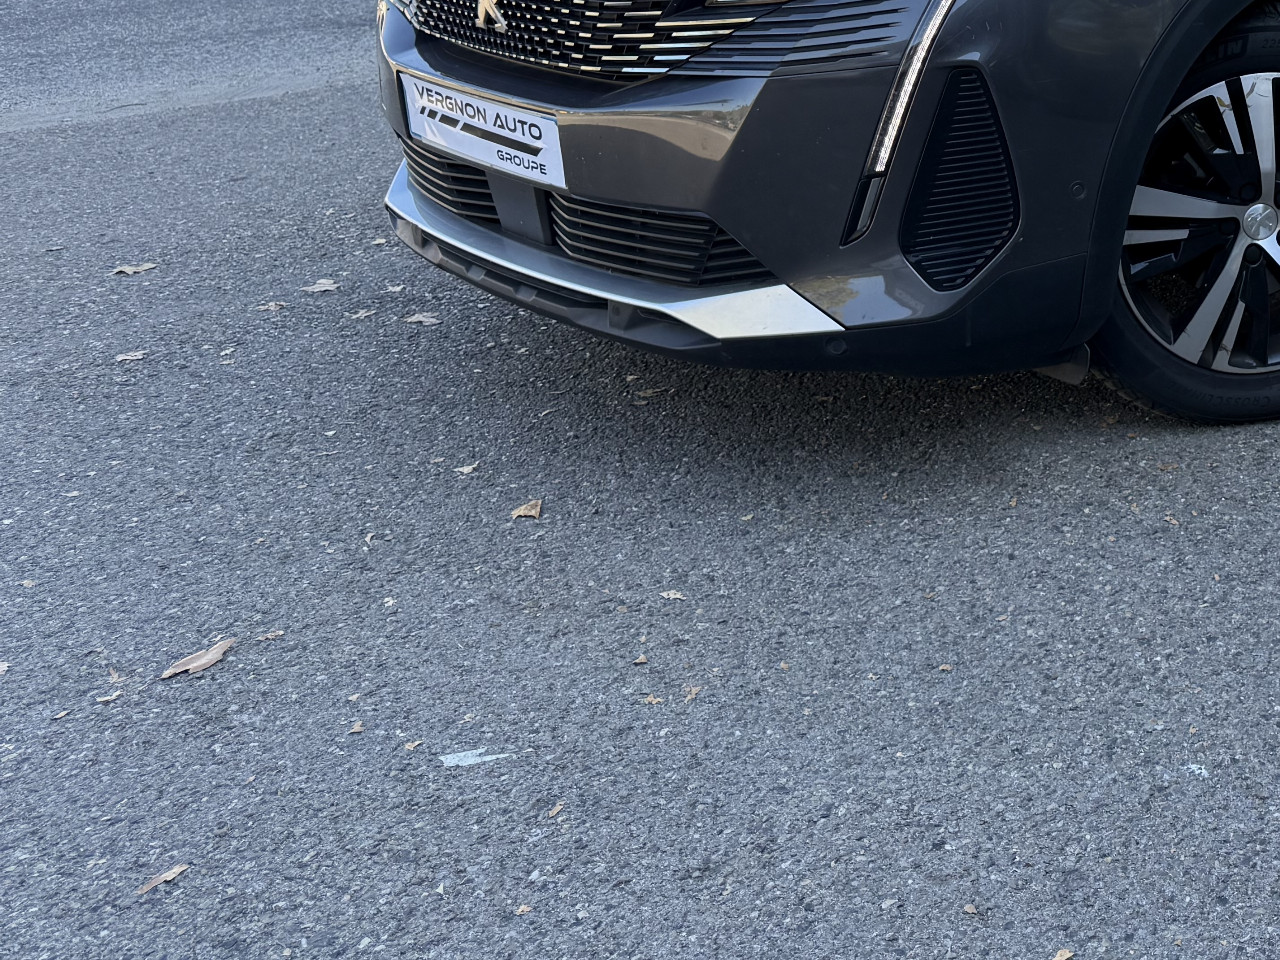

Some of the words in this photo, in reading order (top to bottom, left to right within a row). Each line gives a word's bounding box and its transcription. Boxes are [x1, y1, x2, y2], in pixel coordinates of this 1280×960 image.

[414, 82, 487, 124] VERGNON
[493, 112, 543, 141] AUTO
[496, 149, 548, 176] GROUPE
